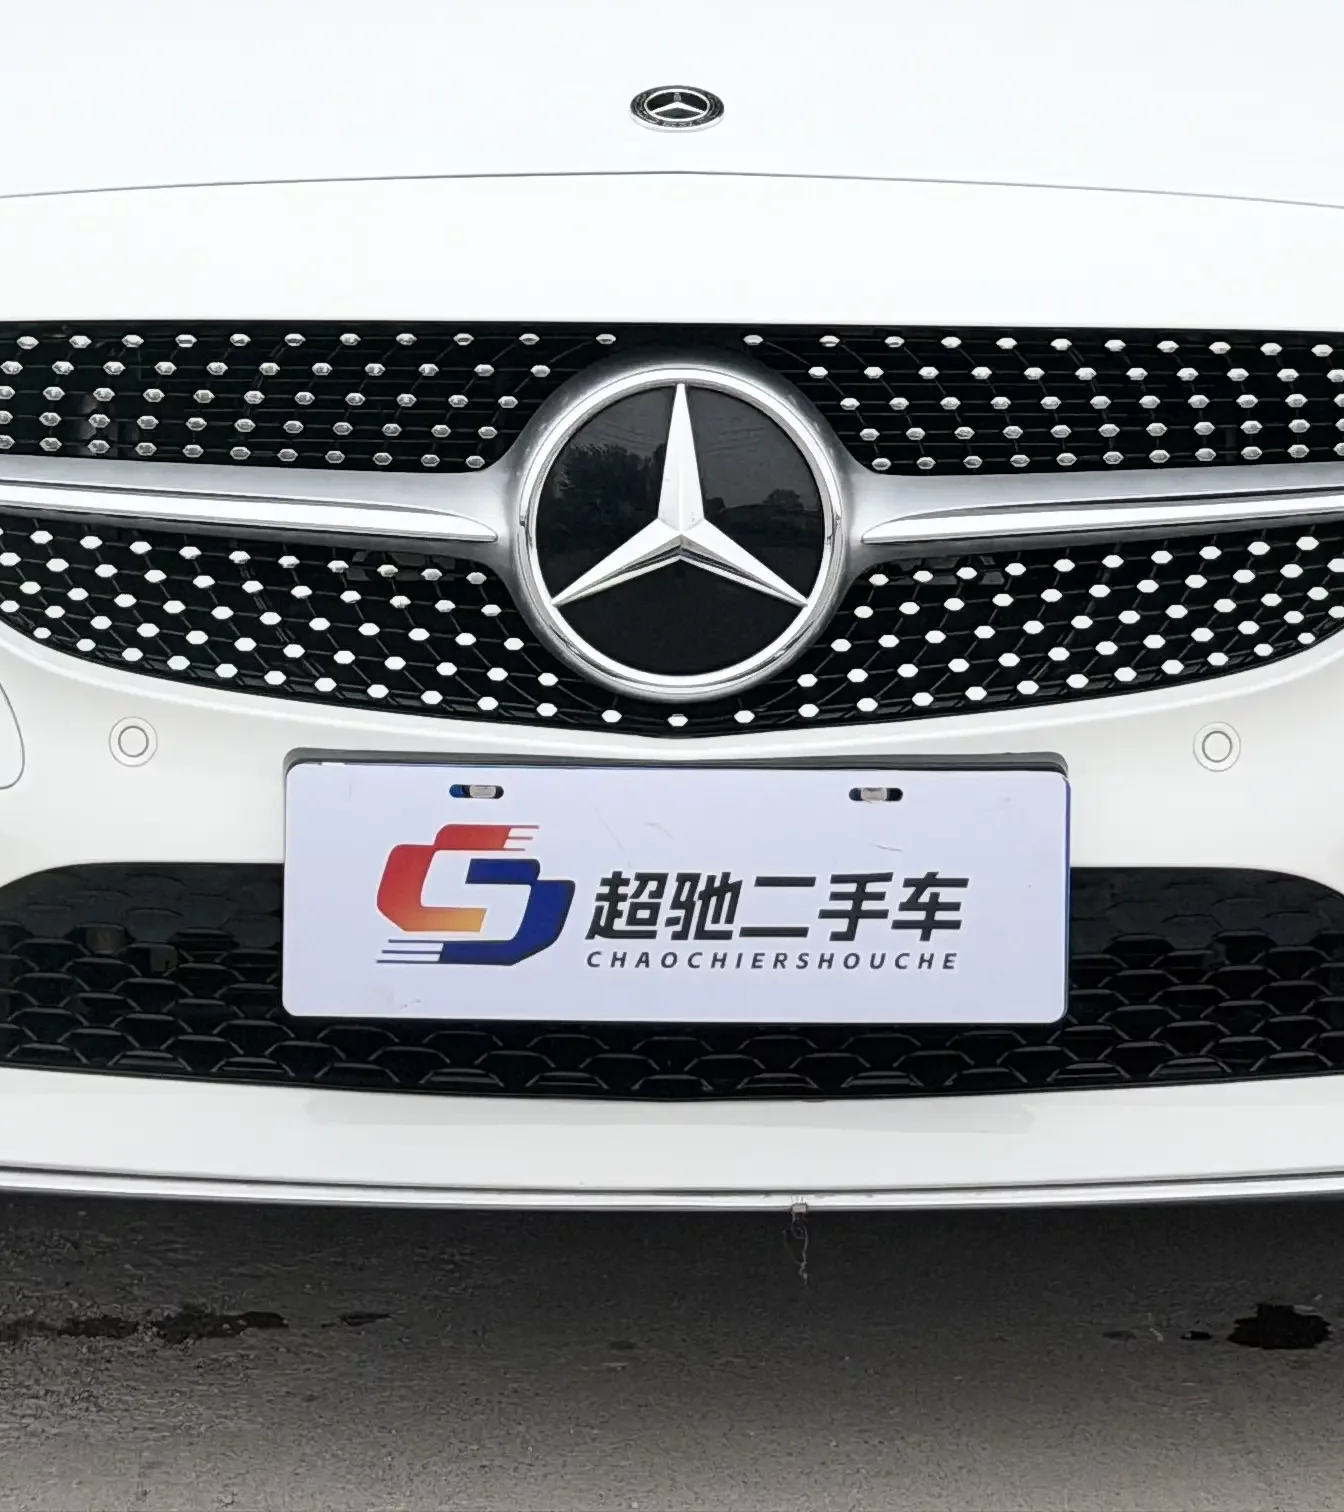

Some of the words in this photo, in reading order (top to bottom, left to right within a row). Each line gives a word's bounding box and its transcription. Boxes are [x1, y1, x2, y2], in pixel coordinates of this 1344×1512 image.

[585, 870, 969, 942] 超驰二手车
[586, 950, 957, 970] CHAOCHIERSHOUCHE
